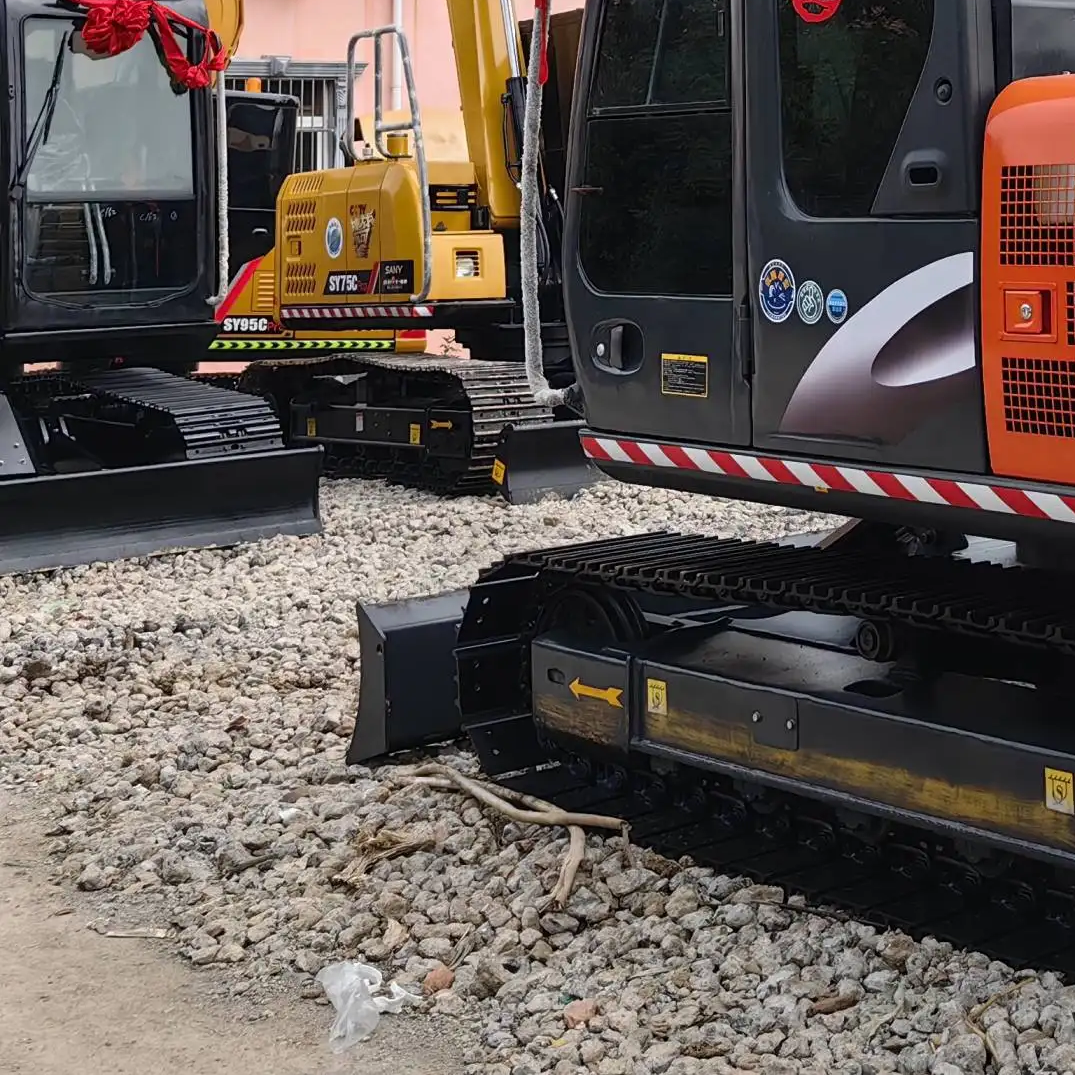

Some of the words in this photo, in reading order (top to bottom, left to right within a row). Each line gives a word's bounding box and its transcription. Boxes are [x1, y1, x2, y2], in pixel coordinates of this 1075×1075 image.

[385, 265, 403, 274] SANY
[329, 275, 357, 292] SY75C
[223, 318, 268, 331] SY95C
